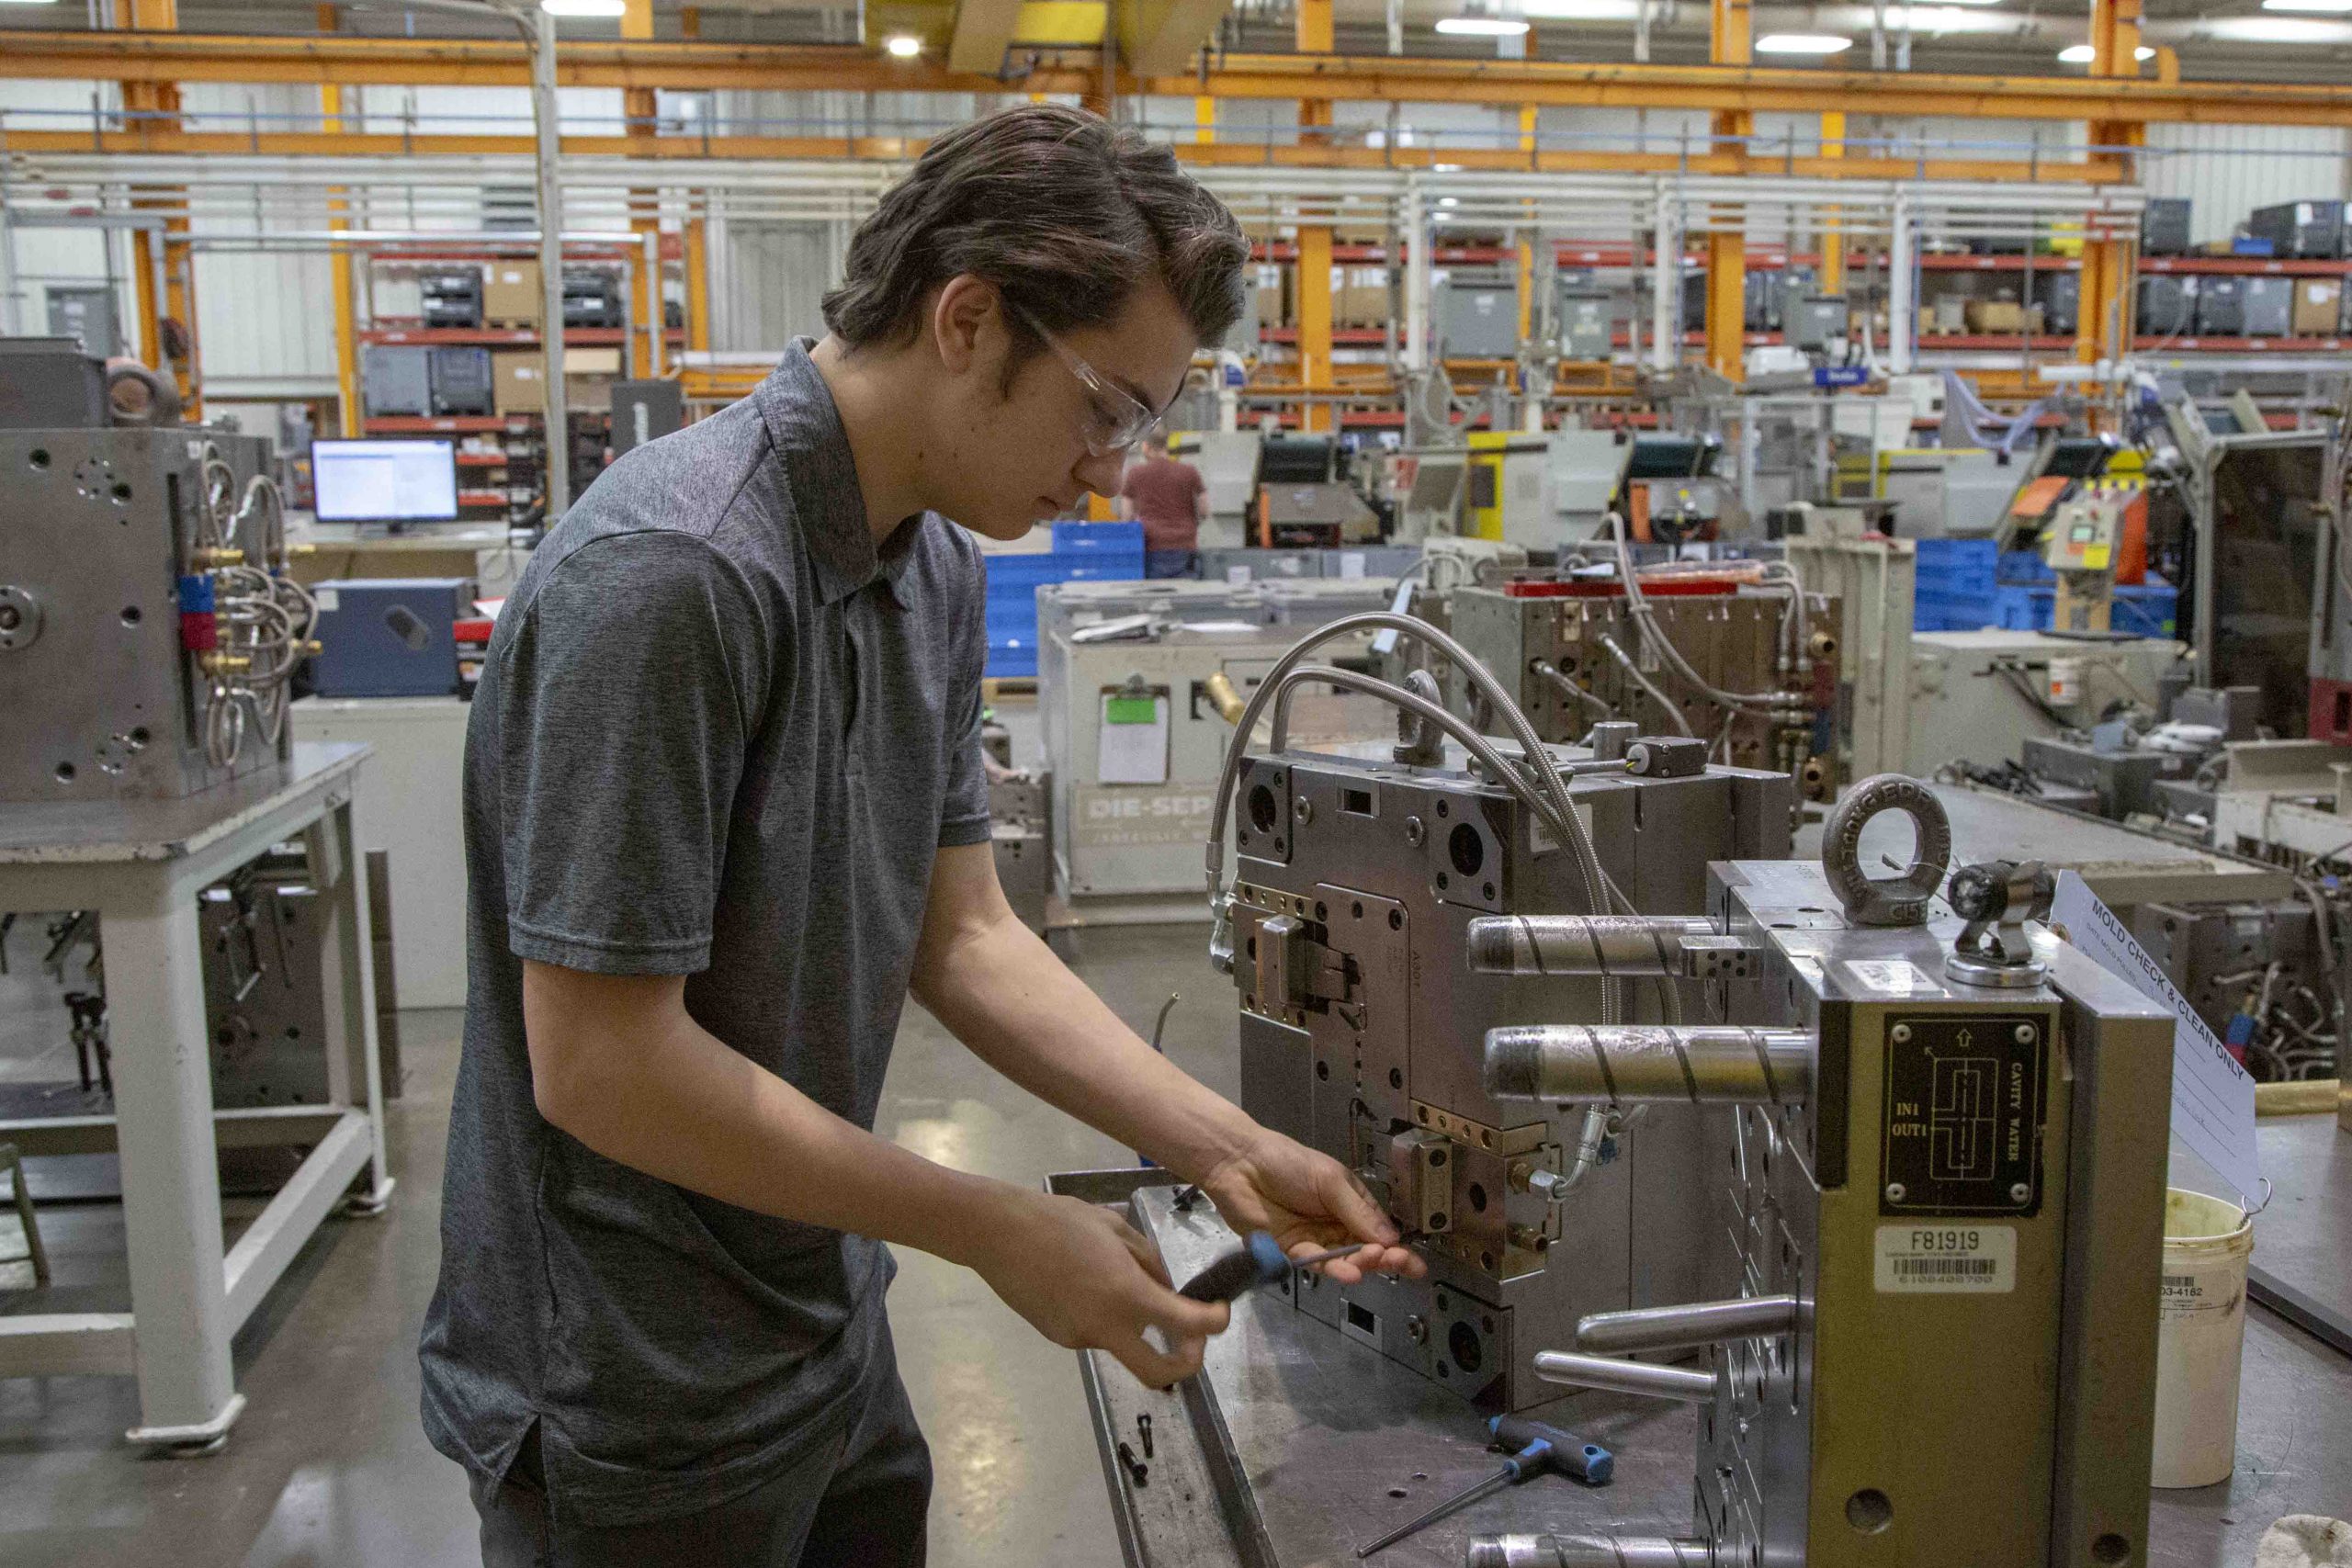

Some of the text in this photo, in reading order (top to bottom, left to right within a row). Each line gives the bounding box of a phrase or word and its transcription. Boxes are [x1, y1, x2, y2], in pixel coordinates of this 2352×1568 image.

[1088, 796, 1213, 818] DIE-SEP
[2092, 899, 2245, 1080] MOLD CHECK & CLEAN ONLY
[1896, 1102, 1919, 1116] IN1
[2007, 1062, 2022, 1162] CAVITY WATER
[1892, 1123, 1927, 1137] OUT1
[1911, 1231, 1979, 1250] F81919
